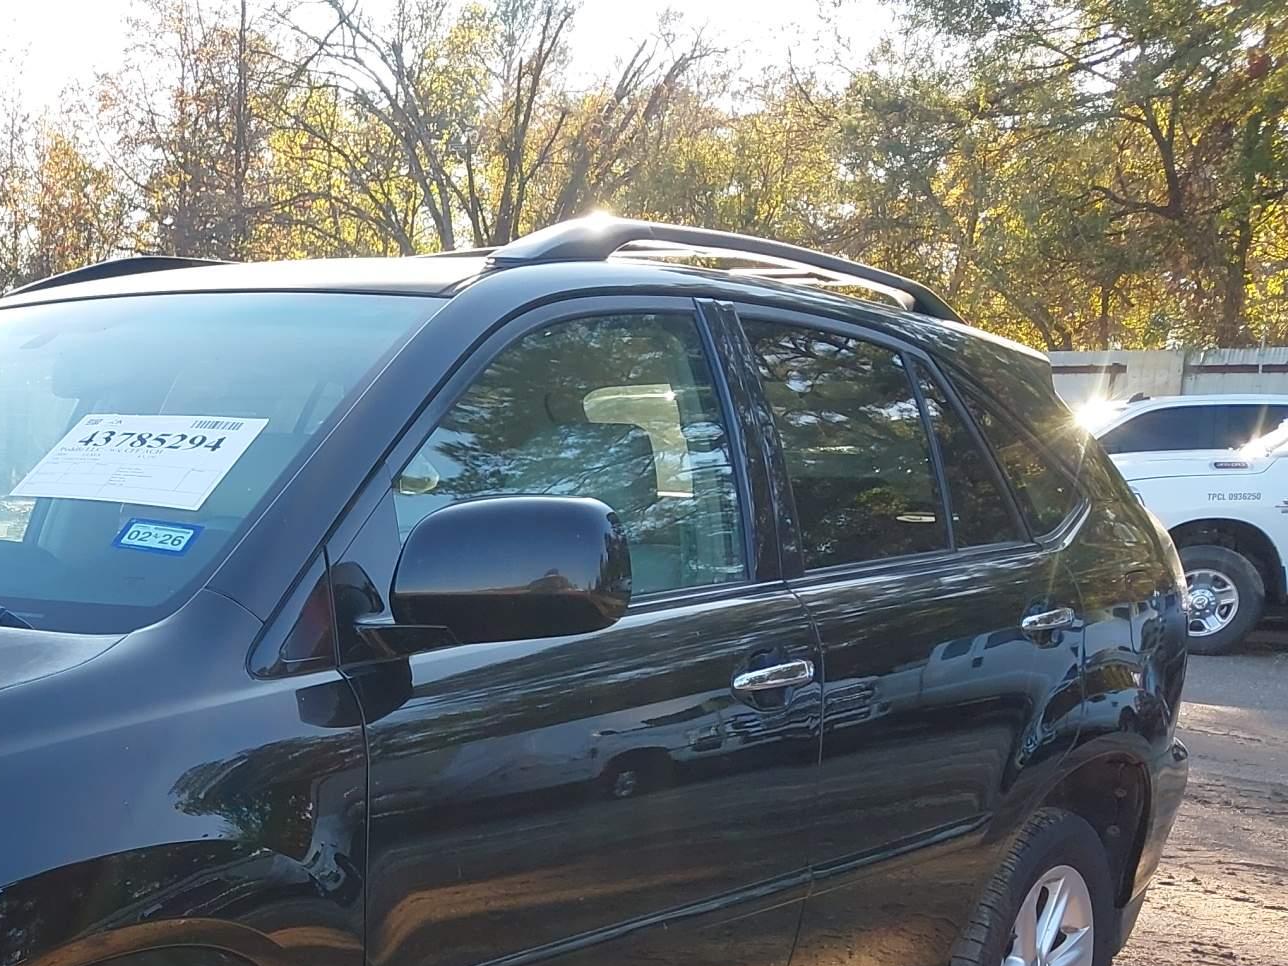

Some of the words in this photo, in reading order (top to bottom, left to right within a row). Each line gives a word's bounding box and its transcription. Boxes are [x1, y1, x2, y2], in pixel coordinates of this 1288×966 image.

[78, 430, 227, 452] 43785294
[127, 529, 153, 542] 02
[158, 533, 185, 547] 26
